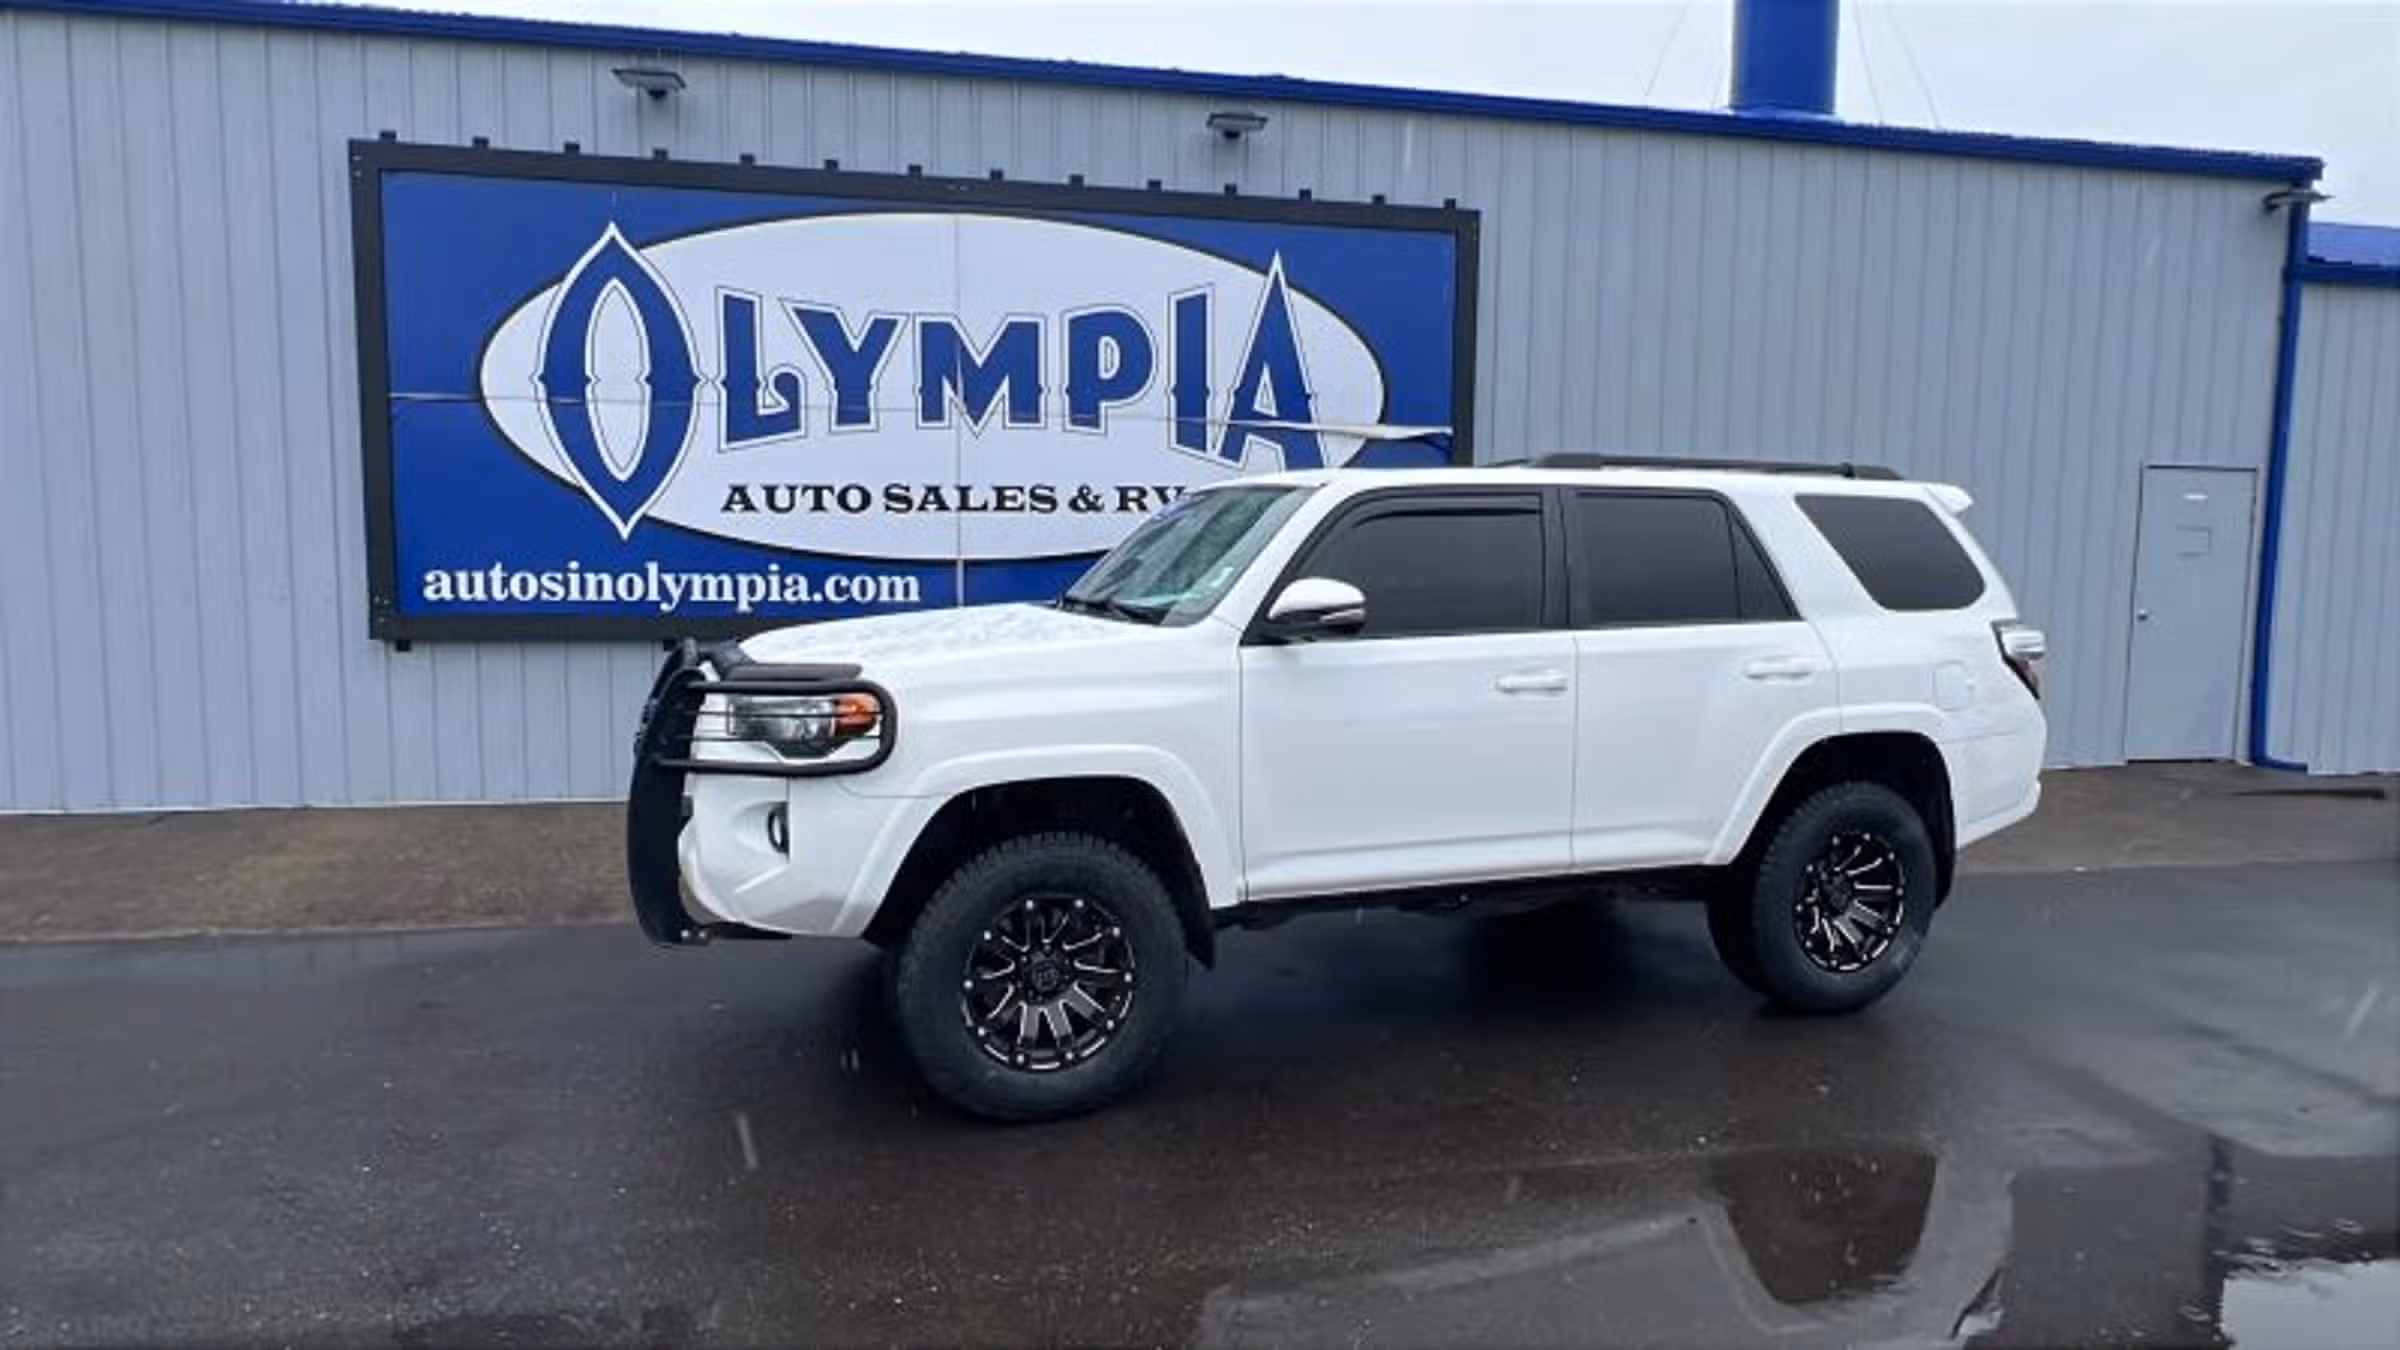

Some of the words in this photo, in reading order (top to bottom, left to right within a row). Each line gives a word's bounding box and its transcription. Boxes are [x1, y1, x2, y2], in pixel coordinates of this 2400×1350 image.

[531, 221, 1330, 541] OLYMPIA
[720, 484, 872, 514] AUTO
[882, 483, 1058, 514] SALES
[1068, 483, 1105, 513] &
[422, 561, 921, 611] autosinolympia.com
